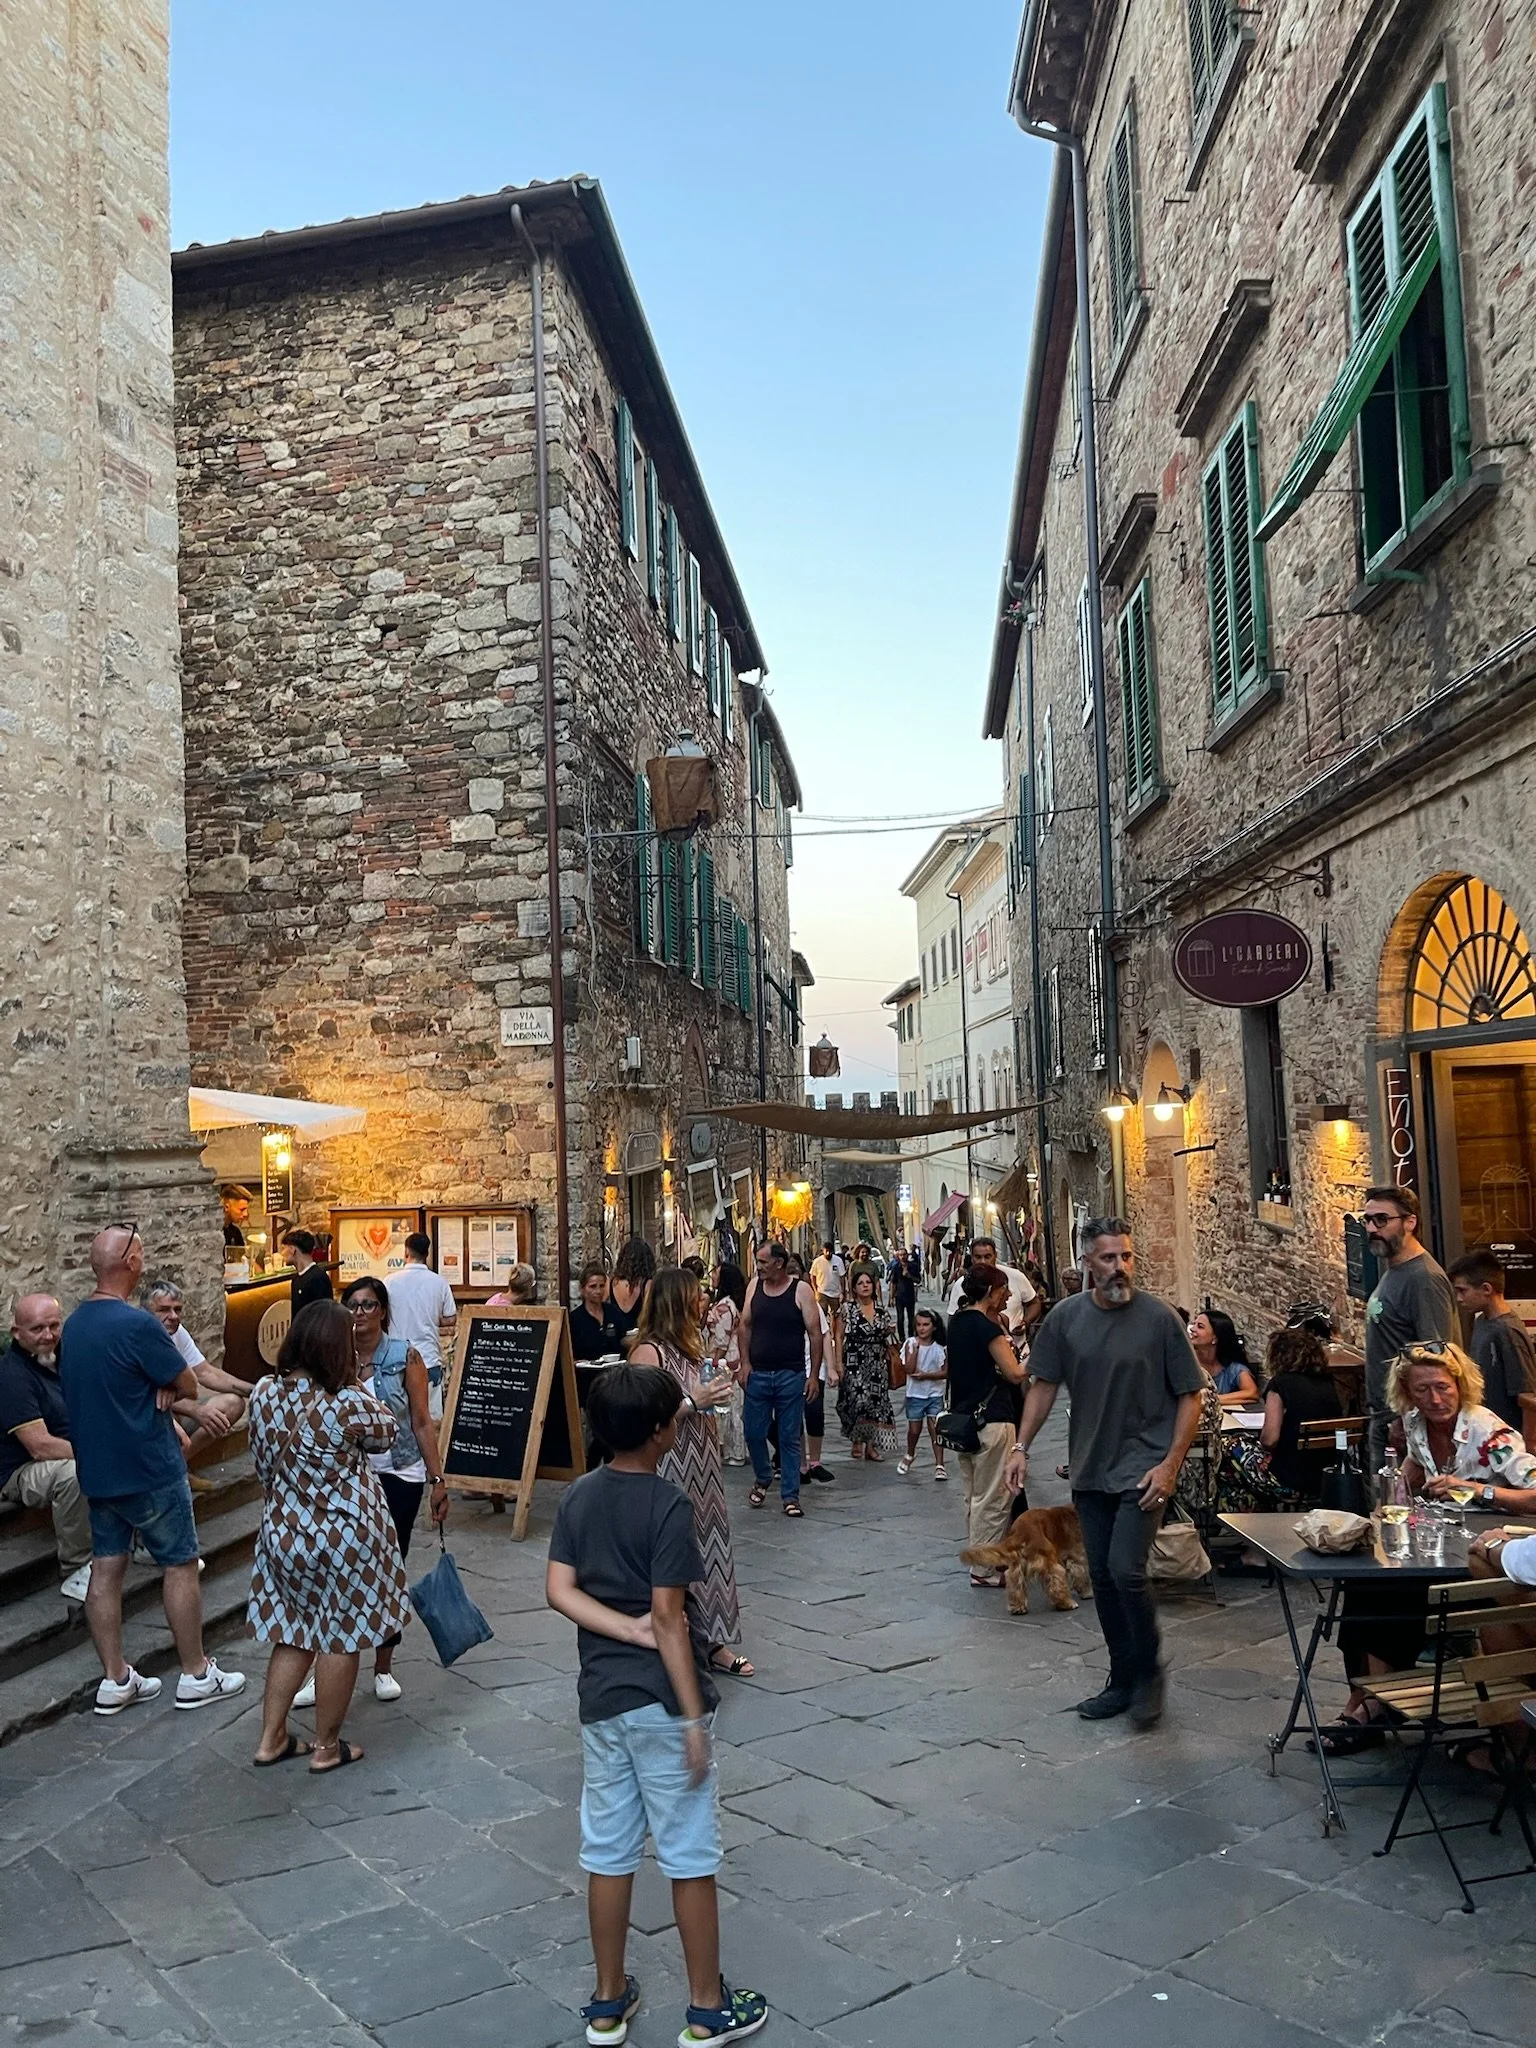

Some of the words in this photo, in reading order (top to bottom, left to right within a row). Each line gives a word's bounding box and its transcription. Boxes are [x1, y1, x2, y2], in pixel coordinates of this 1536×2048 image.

[519, 1011, 535, 1020] VIA
[513, 1021, 541, 1031] DELLA
[505, 1031, 551, 1041] MADONNA
